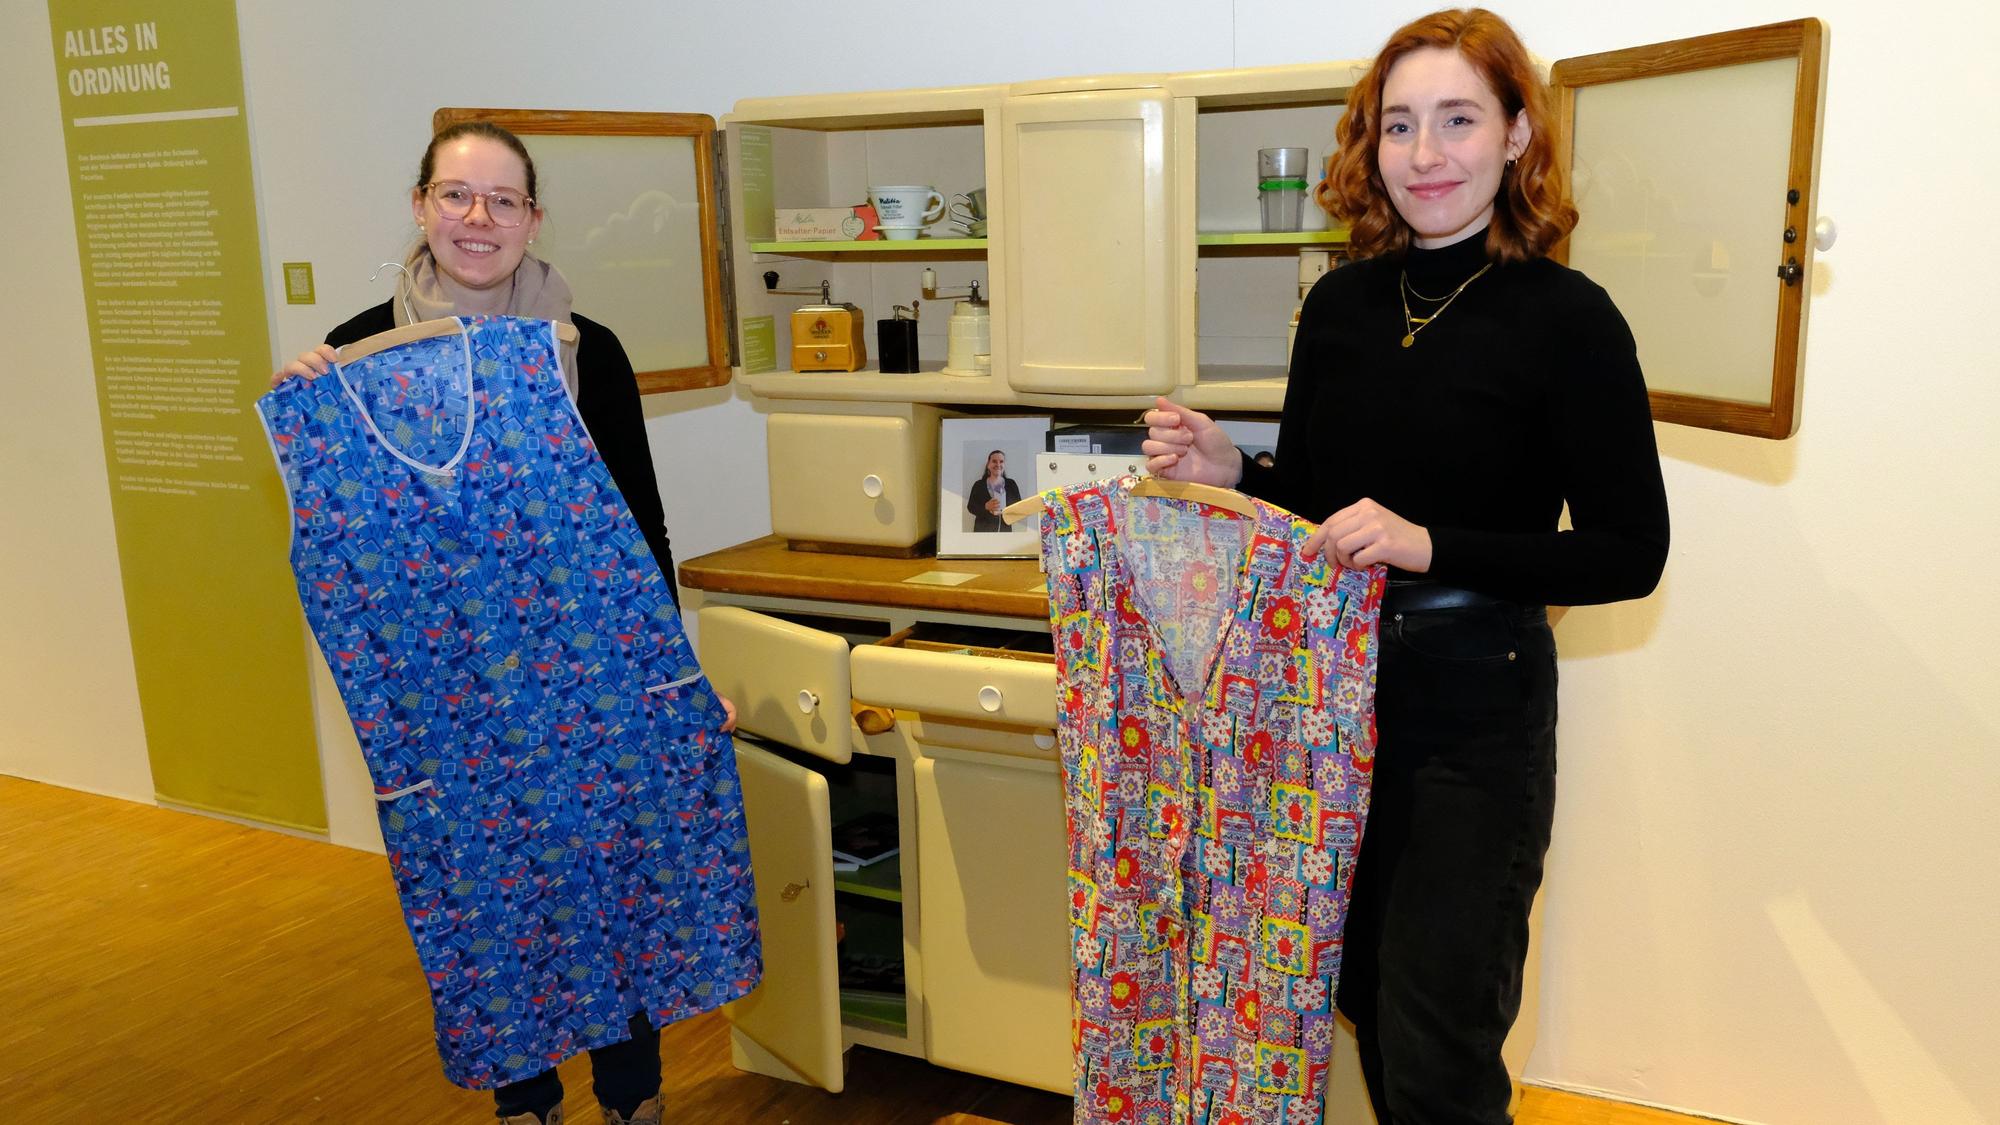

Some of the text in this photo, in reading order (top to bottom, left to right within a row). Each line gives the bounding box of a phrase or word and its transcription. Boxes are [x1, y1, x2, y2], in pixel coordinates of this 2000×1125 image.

[65, 22, 158, 58] ALLES IN
[68, 61, 171, 97] ORDNUNG
